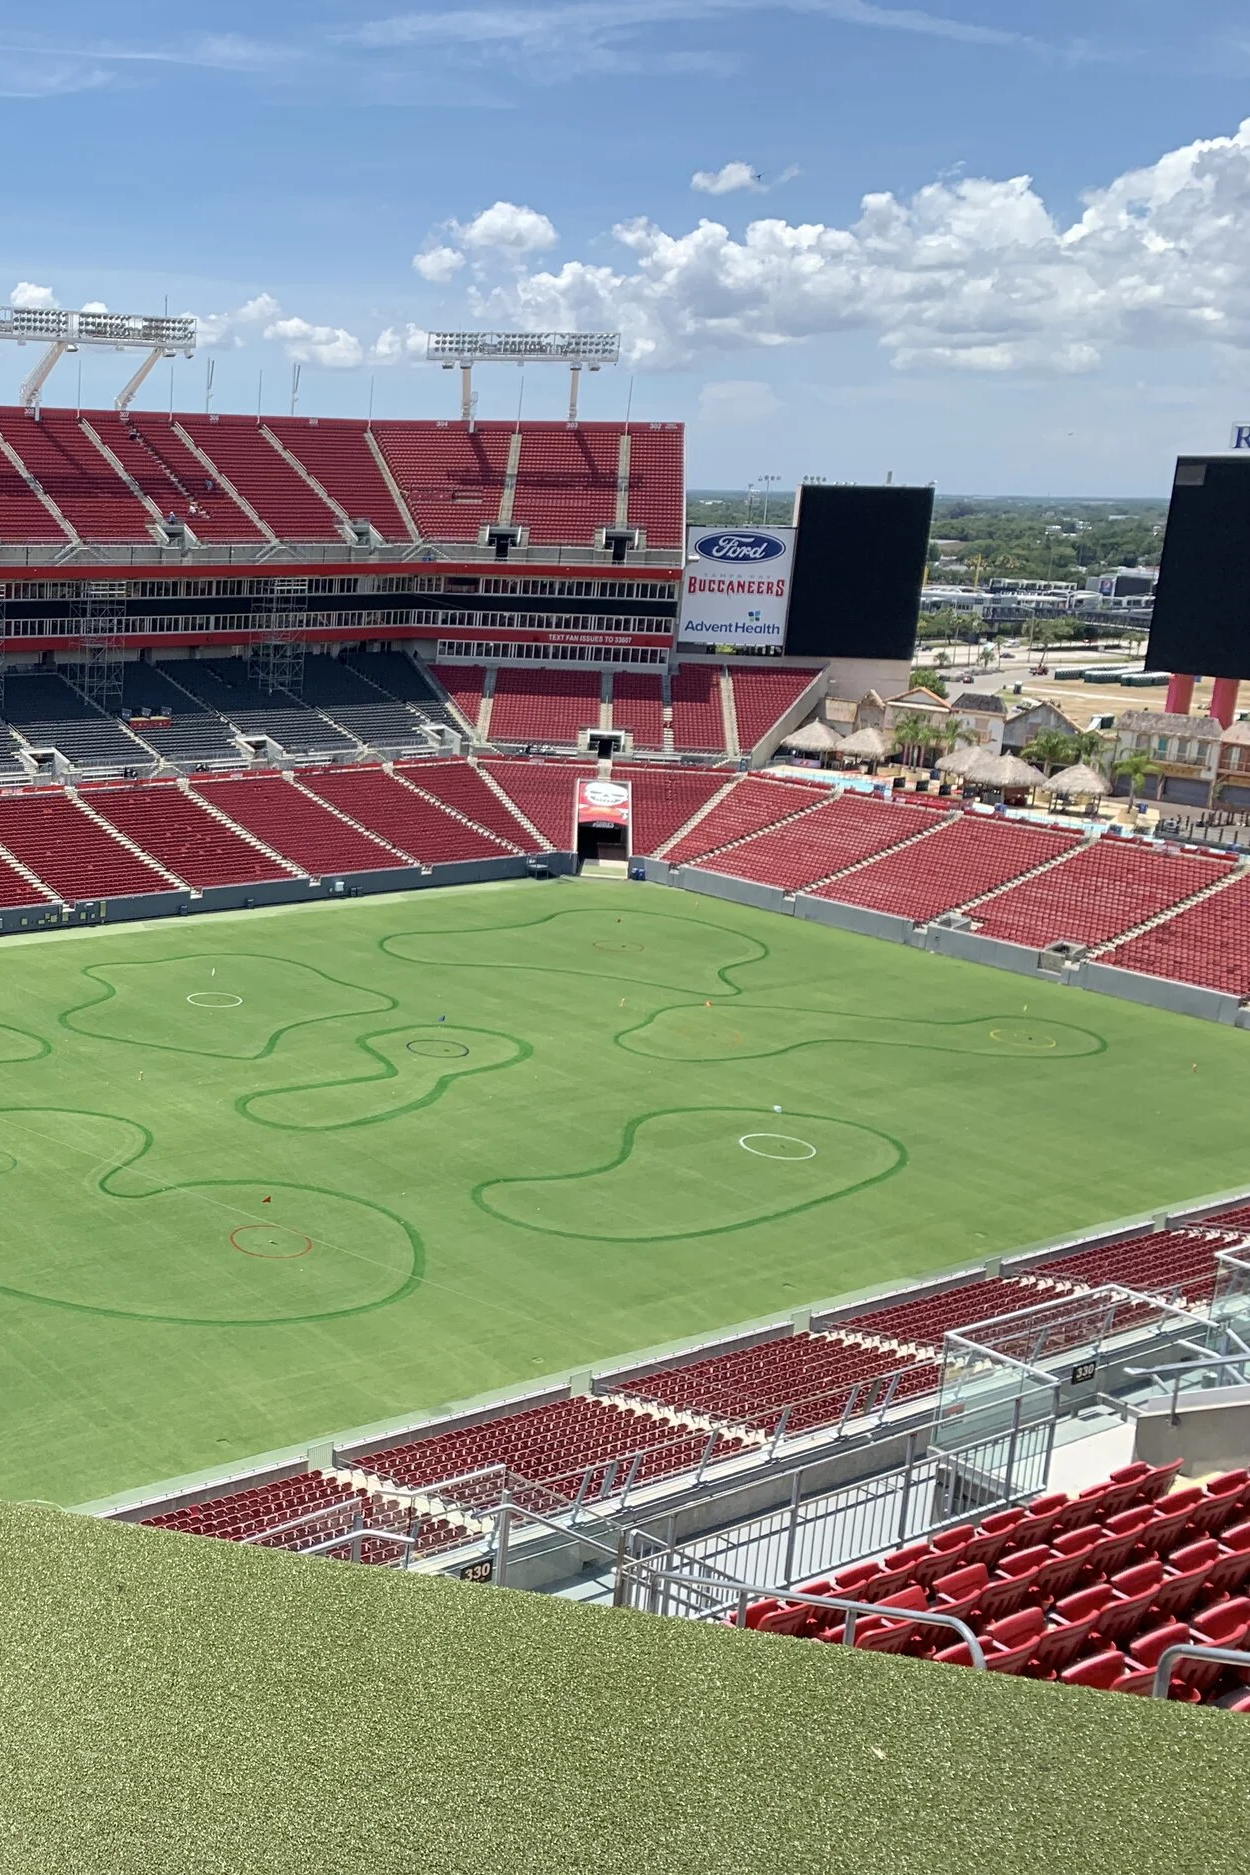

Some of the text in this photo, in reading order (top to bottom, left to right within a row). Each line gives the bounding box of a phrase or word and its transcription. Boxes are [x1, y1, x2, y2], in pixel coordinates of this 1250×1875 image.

[712, 535, 768, 558] Ford
[688, 576, 785, 597] BUCCANEERS
[549, 633, 564, 641] TEXT
[579, 635, 604, 643] ISSUES
[1075, 1363, 1094, 1378] 330
[464, 1562, 491, 1581] 330
